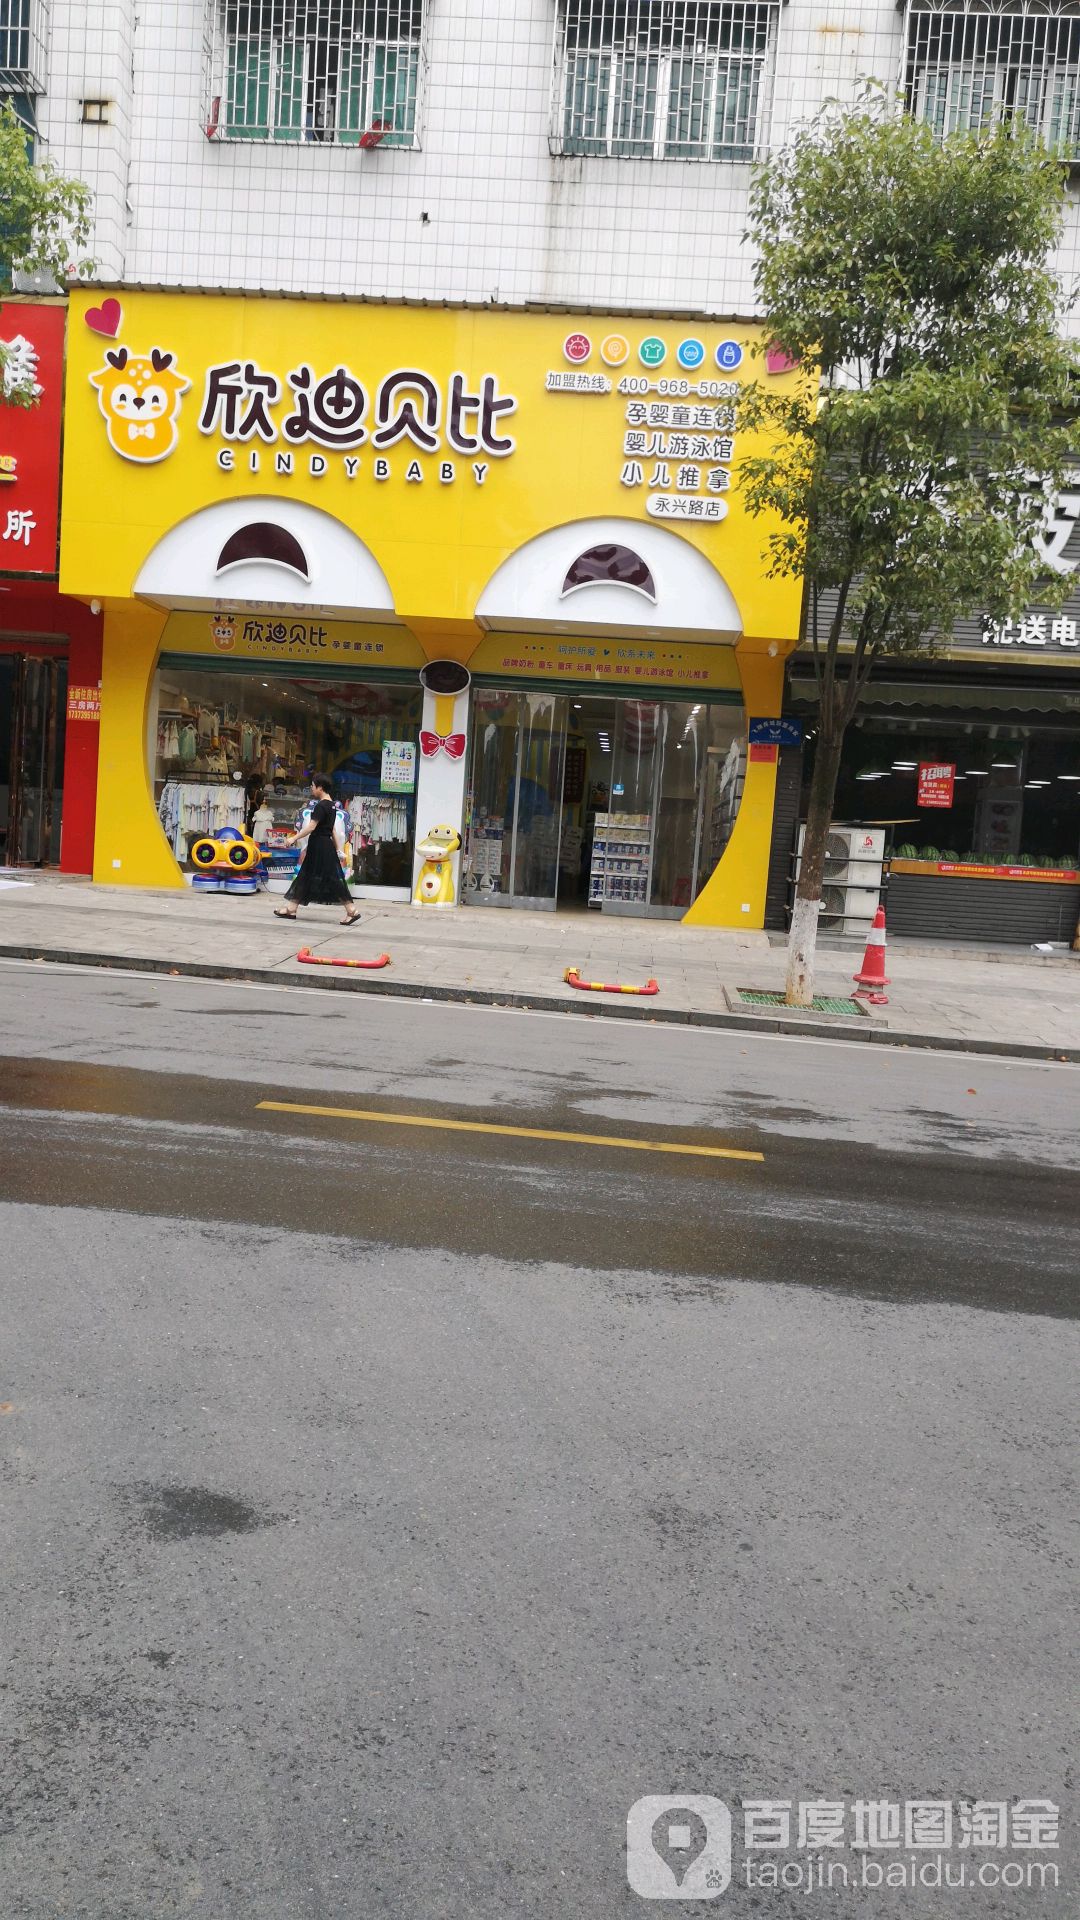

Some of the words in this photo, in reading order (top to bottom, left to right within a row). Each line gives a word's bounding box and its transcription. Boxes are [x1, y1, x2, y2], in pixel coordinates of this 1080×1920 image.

[620, 377, 739, 397] 400-968-5020
[200, 361, 516, 455] 欣迪贝比
[625, 432, 733, 460] 婴儿游泳馆
[217, 448, 491, 484] CINDYBABY
[622, 462, 730, 490] 小儿推拿
[655, 496, 721, 517] 永兴路店
[2, 509, 37, 546] 所
[242, 620, 328, 648] 欣迪贝比
[331, 640, 385, 653] 孕婴童连锁
[247, 644, 319, 655] CINDYBABY
[921, 766, 952, 781] 招聘
